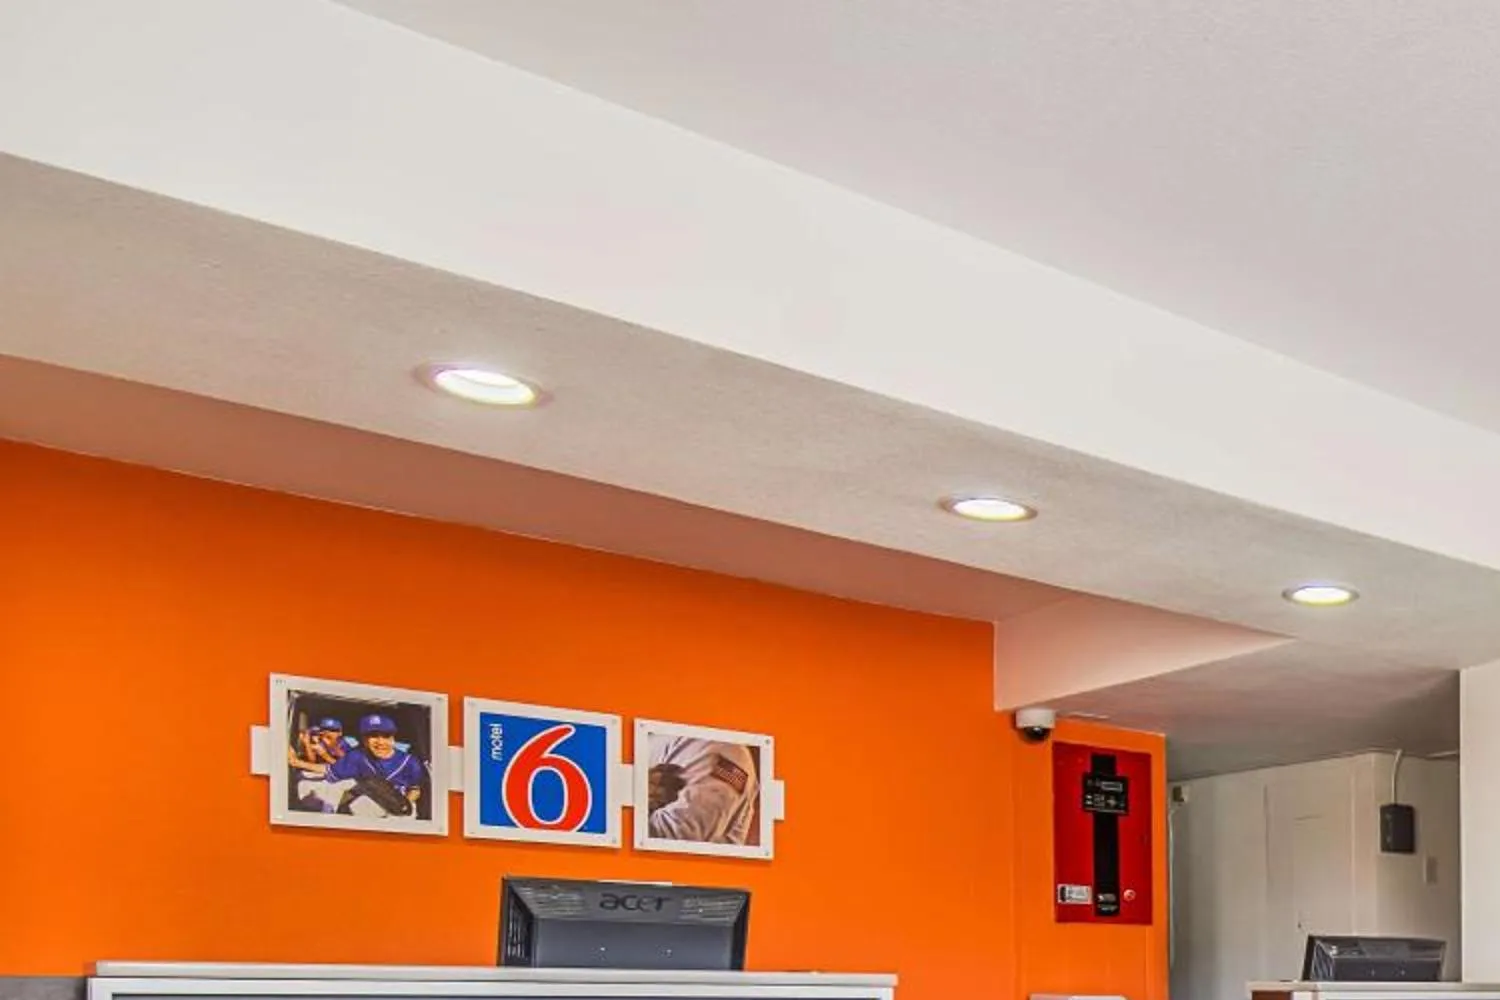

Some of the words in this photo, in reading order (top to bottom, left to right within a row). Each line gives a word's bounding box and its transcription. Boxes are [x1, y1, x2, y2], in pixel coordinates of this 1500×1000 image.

[489, 723, 503, 761] motel
[502, 724, 593, 832] 6
[599, 892, 672, 912] acer
